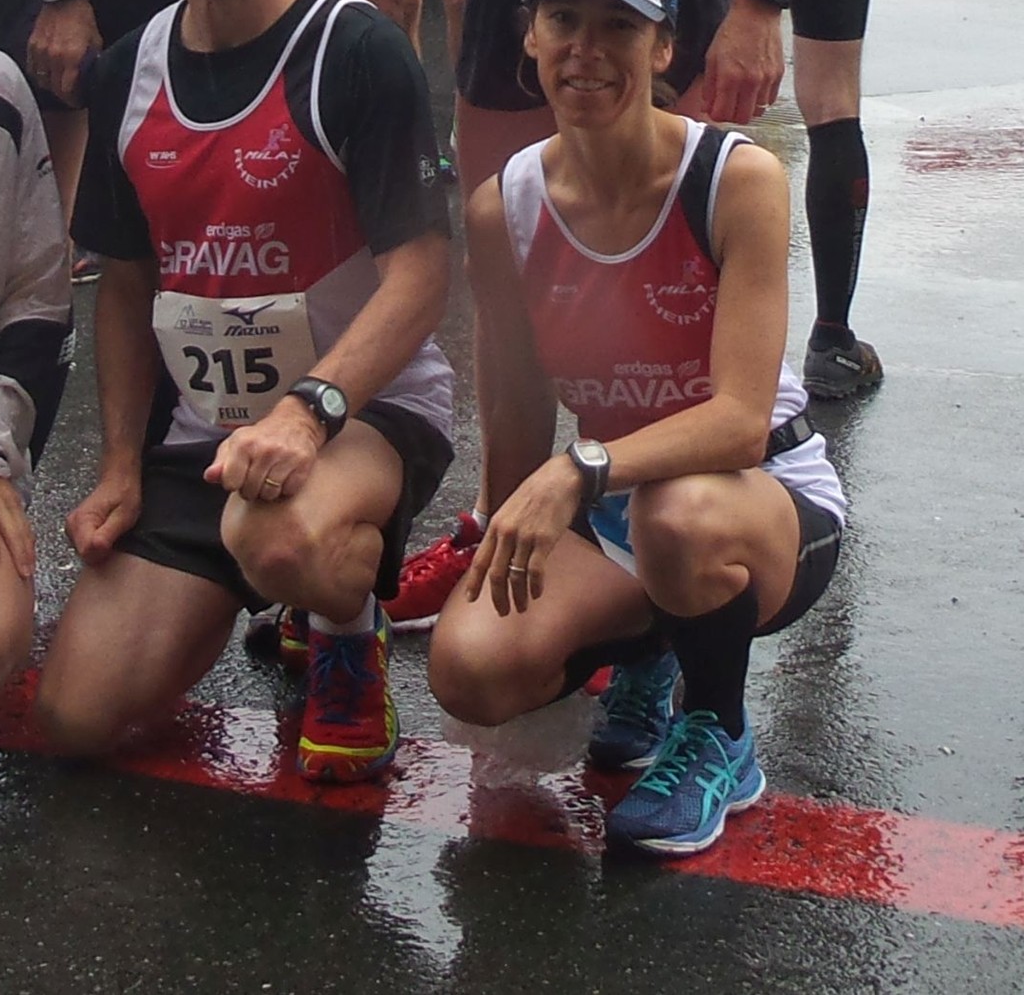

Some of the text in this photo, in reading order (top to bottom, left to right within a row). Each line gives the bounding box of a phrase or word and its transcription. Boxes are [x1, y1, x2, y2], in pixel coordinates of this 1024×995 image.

[205, 222, 251, 240] erdgas
[160, 240, 290, 276] GRAVAG
[182, 345, 280, 395] 215
[613, 360, 674, 377] erdgas
[218, 407, 250, 420] FELIX
